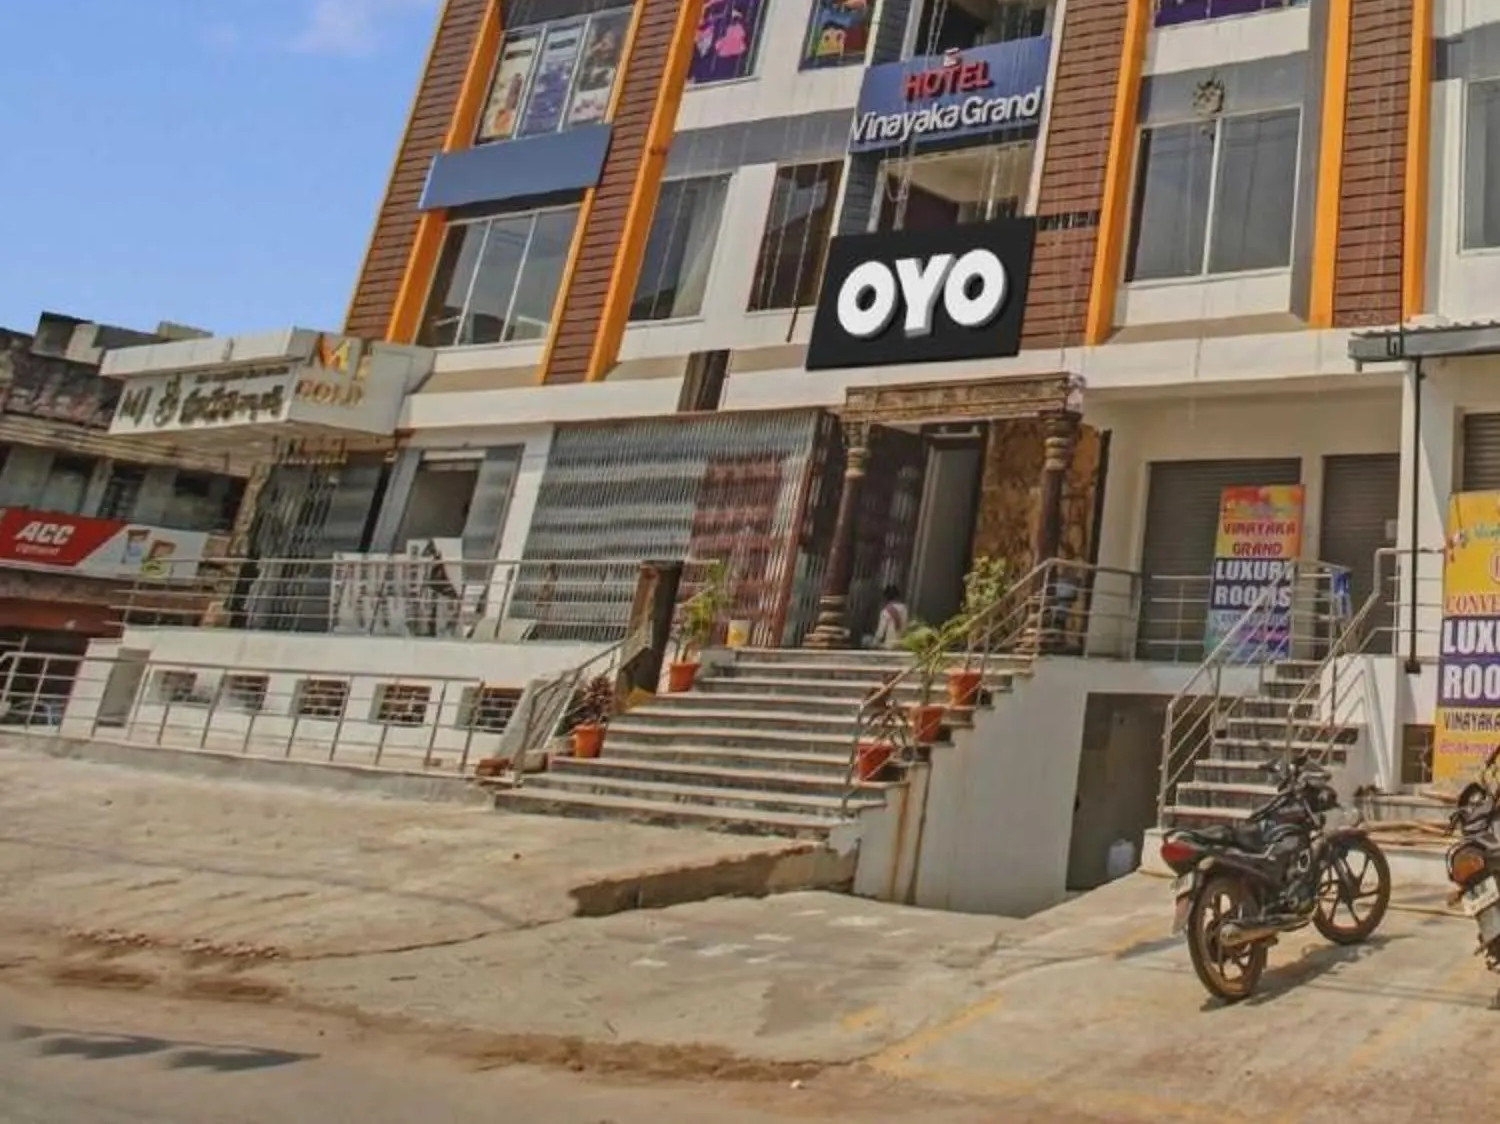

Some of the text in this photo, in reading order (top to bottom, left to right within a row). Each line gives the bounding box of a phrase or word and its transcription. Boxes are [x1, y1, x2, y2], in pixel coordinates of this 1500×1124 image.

[905, 61, 993, 101] HOTEL
[852, 86, 1041, 142] Vinayaka Grand
[837, 249, 1007, 337] OYO
[13, 521, 77, 546] ACC
[1224, 521, 1295, 535] VINAYAKA
[1232, 541, 1282, 556] GRAND
